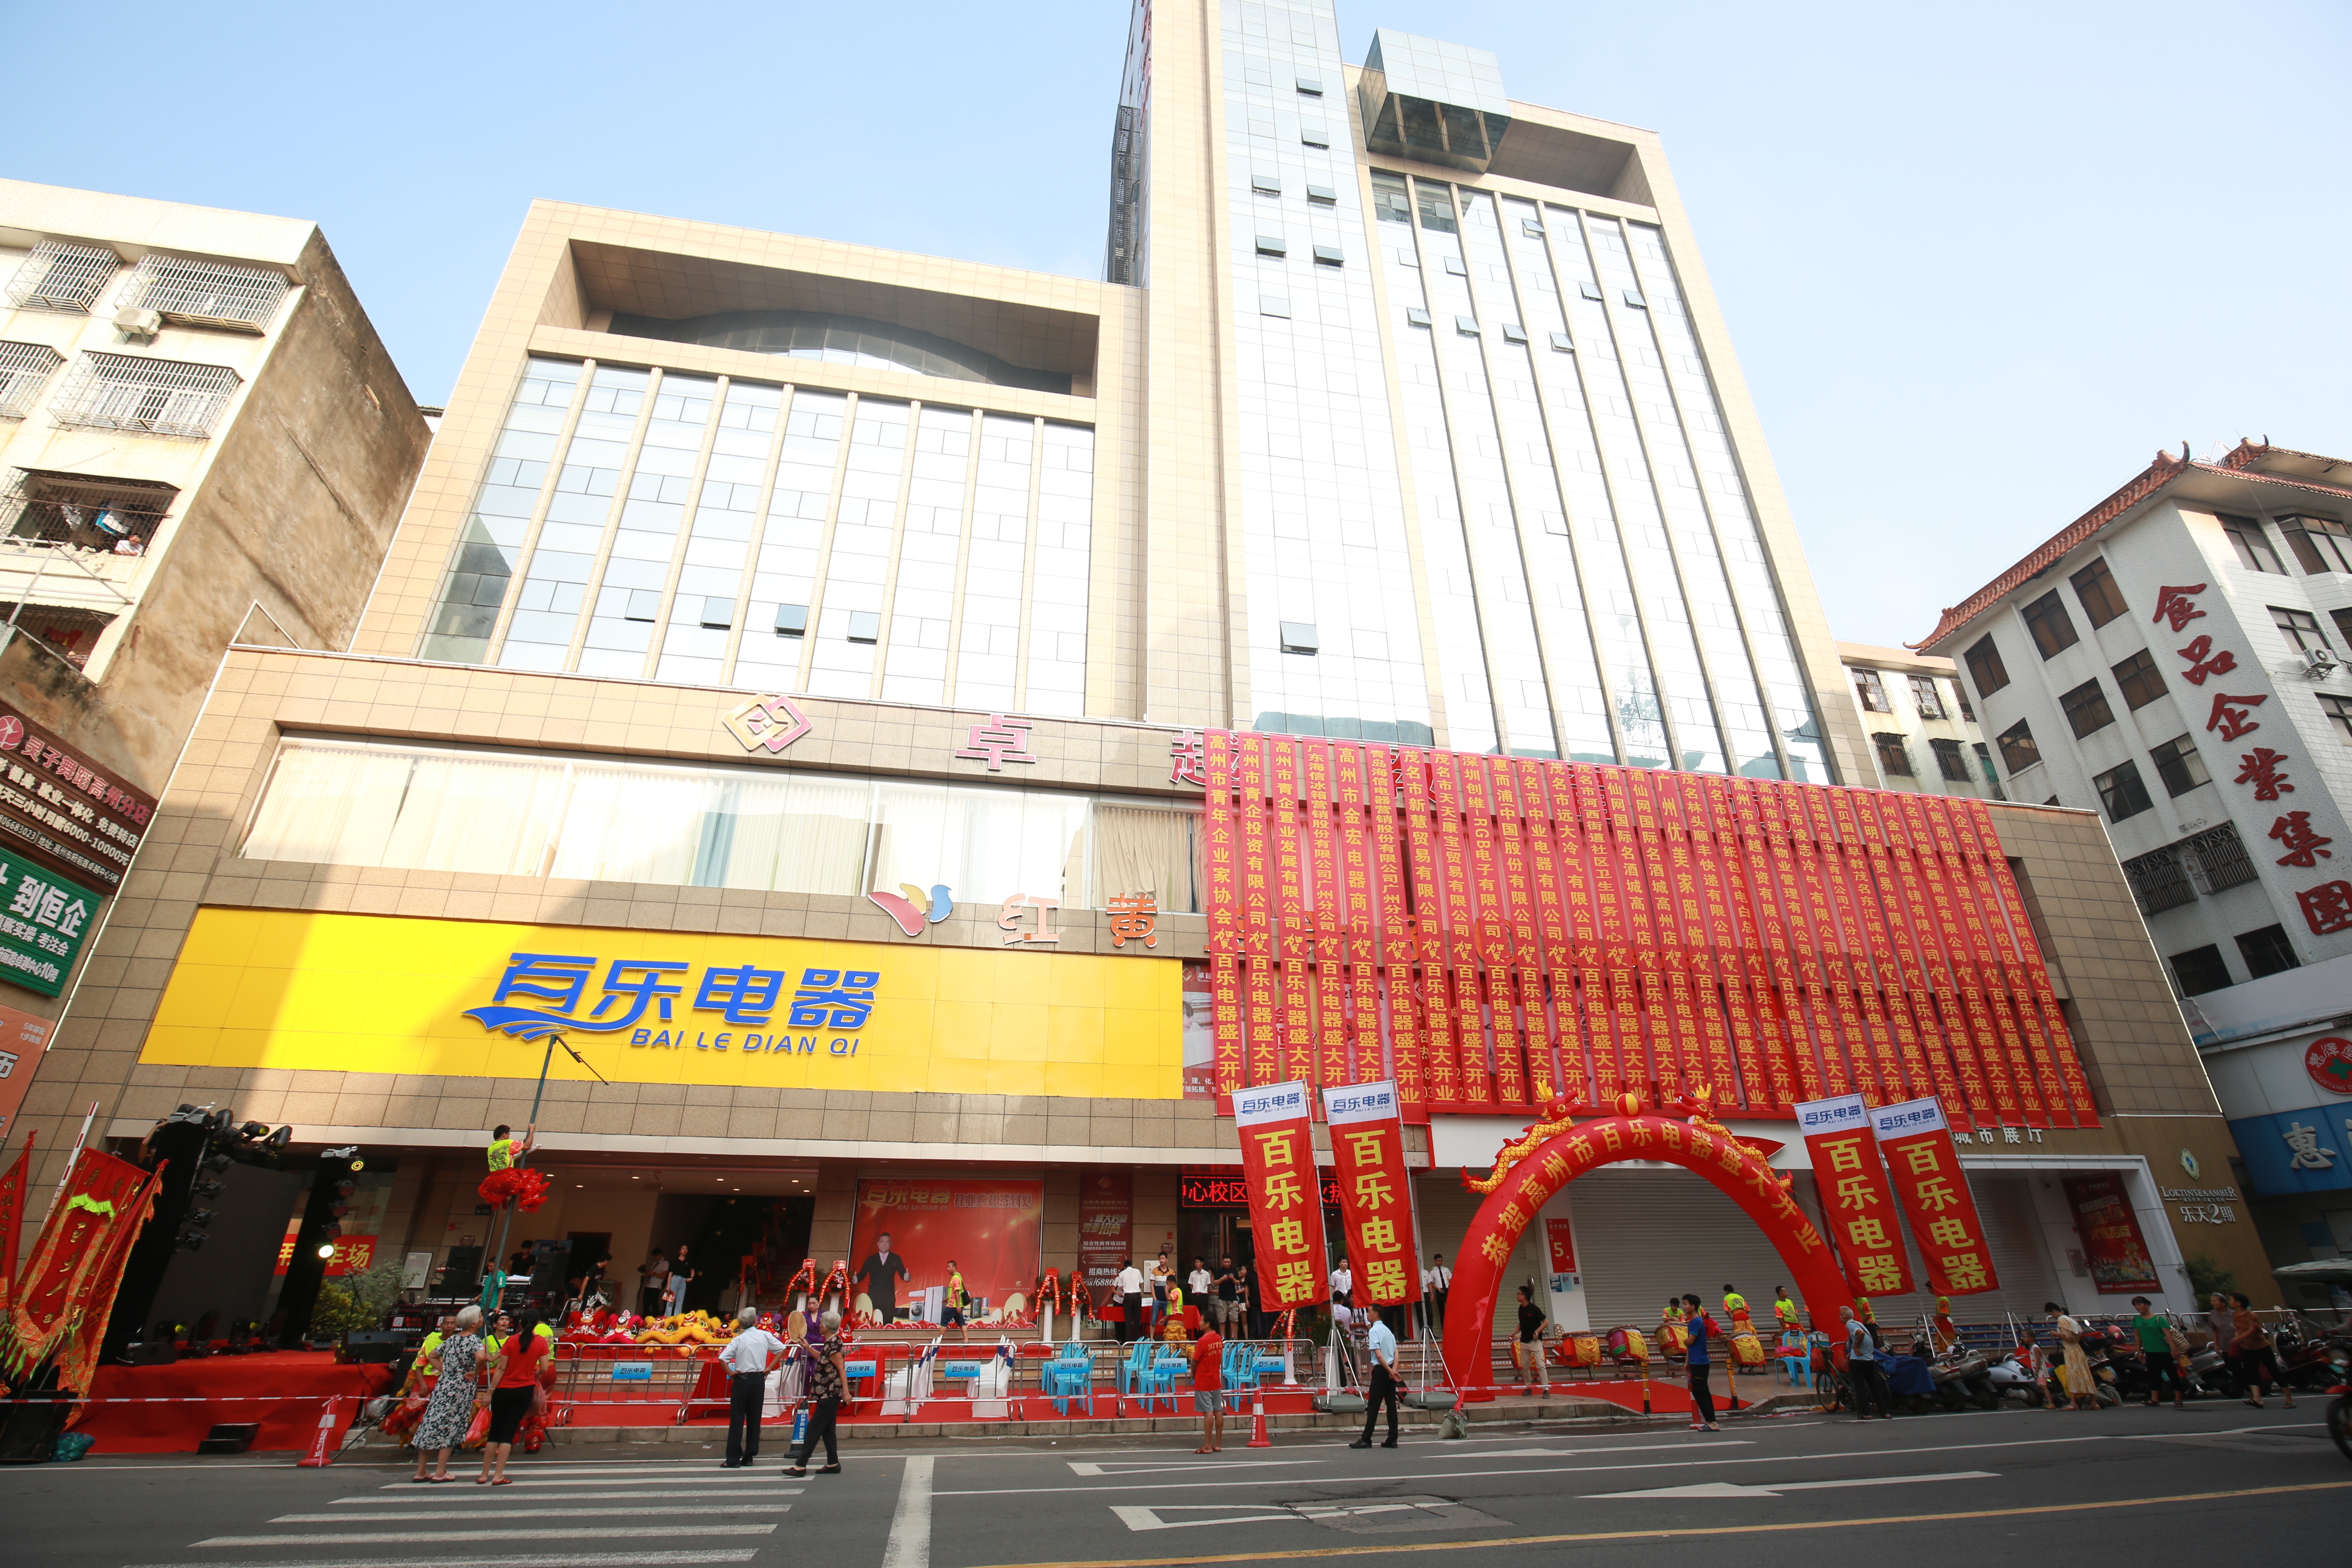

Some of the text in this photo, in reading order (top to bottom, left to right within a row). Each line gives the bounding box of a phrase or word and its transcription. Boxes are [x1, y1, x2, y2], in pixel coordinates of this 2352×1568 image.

[21, 735, 151, 825] 灵子舞蹈高州分店
[8, 765, 36, 790] 健身
[96, 818, 140, 849] 免费转店
[9, 875, 87, 938] 到恒企
[37, 932, 69, 957] 考注会
[461, 952, 880, 1031] 百乐电器
[23, 1022, 46, 1036] 5年耕耘
[630, 1027, 860, 1056] BAI LE DIAN QI
[1242, 1092, 1300, 1110] 百乐电器
[1333, 1093, 1390, 1111] 百乐电器
[1805, 1105, 1861, 1123] 百乐电器
[1879, 1107, 1936, 1127] 百乐电器
[866, 1185, 952, 1205] 百乐电器
[953, 1193, 1033, 1209] 开业典礼签到处
[1481, 1118, 1821, 1268] 恭贺高州市百乐电器盛大开业
[1254, 1129, 1315, 1303] 百乐电器
[1344, 1129, 1407, 1301] 百乐电器
[1820, 1137, 1902, 1292] 百乐电器
[1897, 1140, 1987, 1290] 百乐电器
[2180, 1203, 2236, 1224] 乐天2期
[1554, 1242, 1564, 1257] 5
